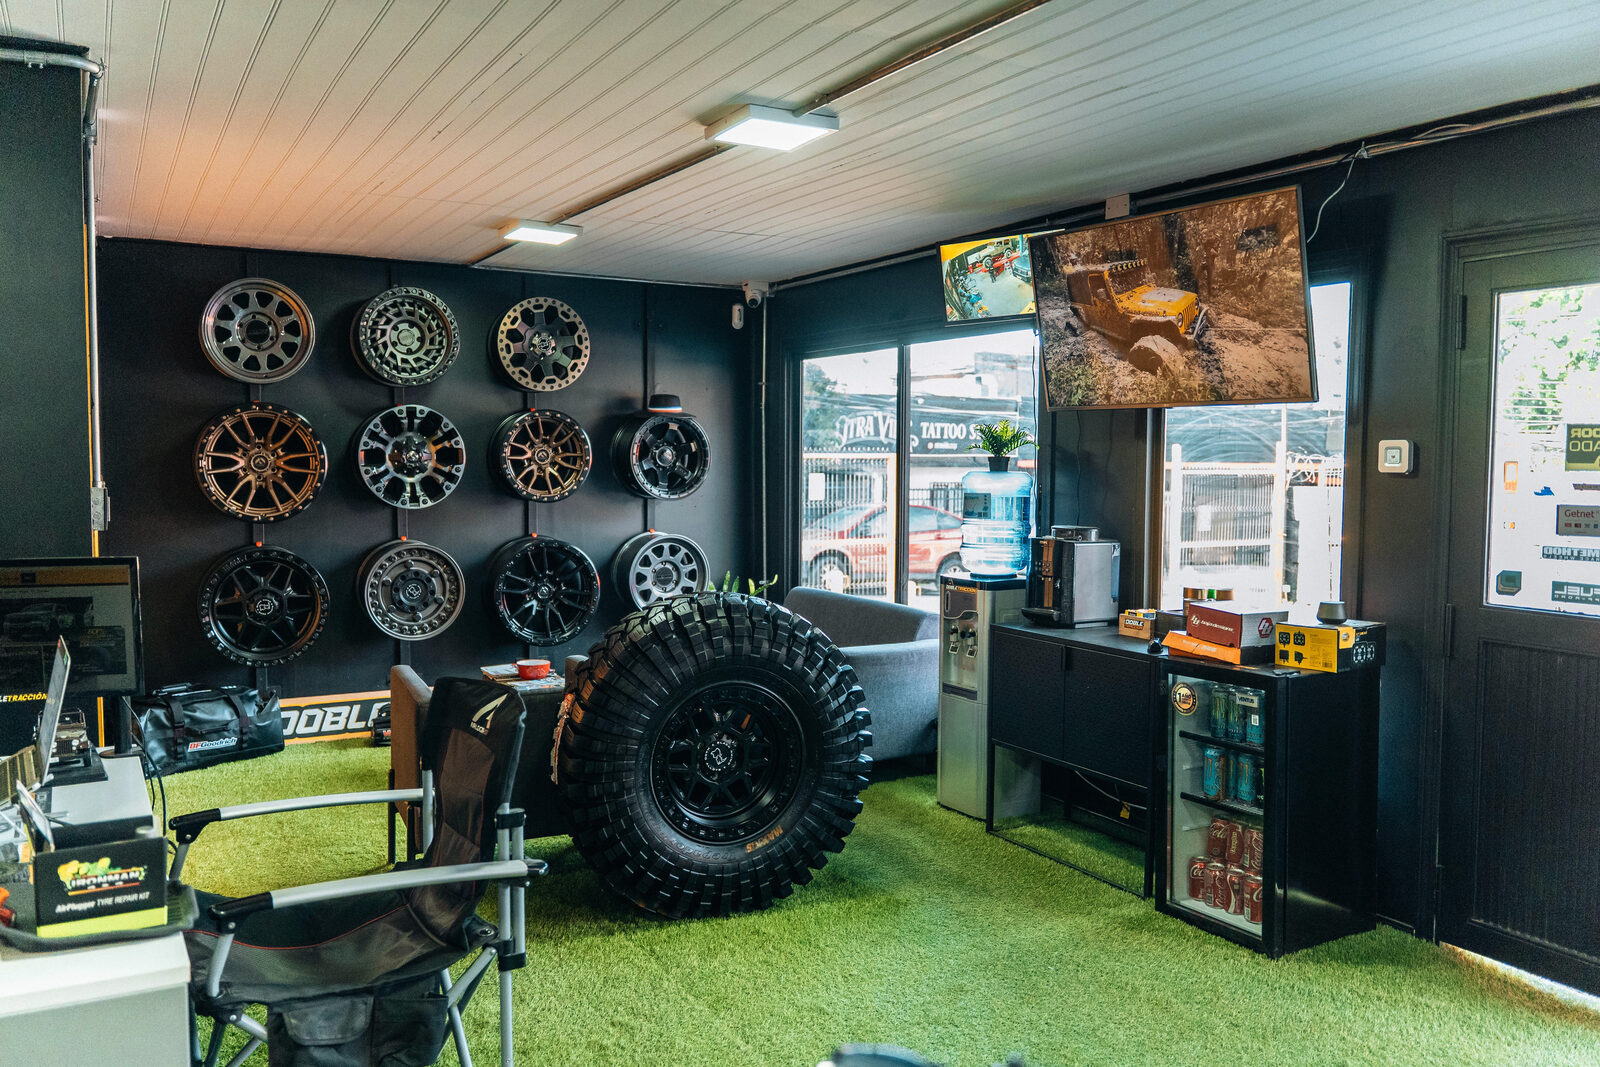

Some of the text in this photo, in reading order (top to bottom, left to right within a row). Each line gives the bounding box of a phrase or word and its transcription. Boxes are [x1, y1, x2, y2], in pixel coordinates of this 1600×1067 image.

[920, 421, 967, 439] TATTOO
[1564, 509, 1595, 519] Getnet
[189, 737, 238, 749] BFGoodrich
[71, 870, 140, 887] IRONMAN
[97, 896, 113, 906] TYRE
[115, 893, 138, 904] REPAIR
[139, 891, 150, 901] KIT
